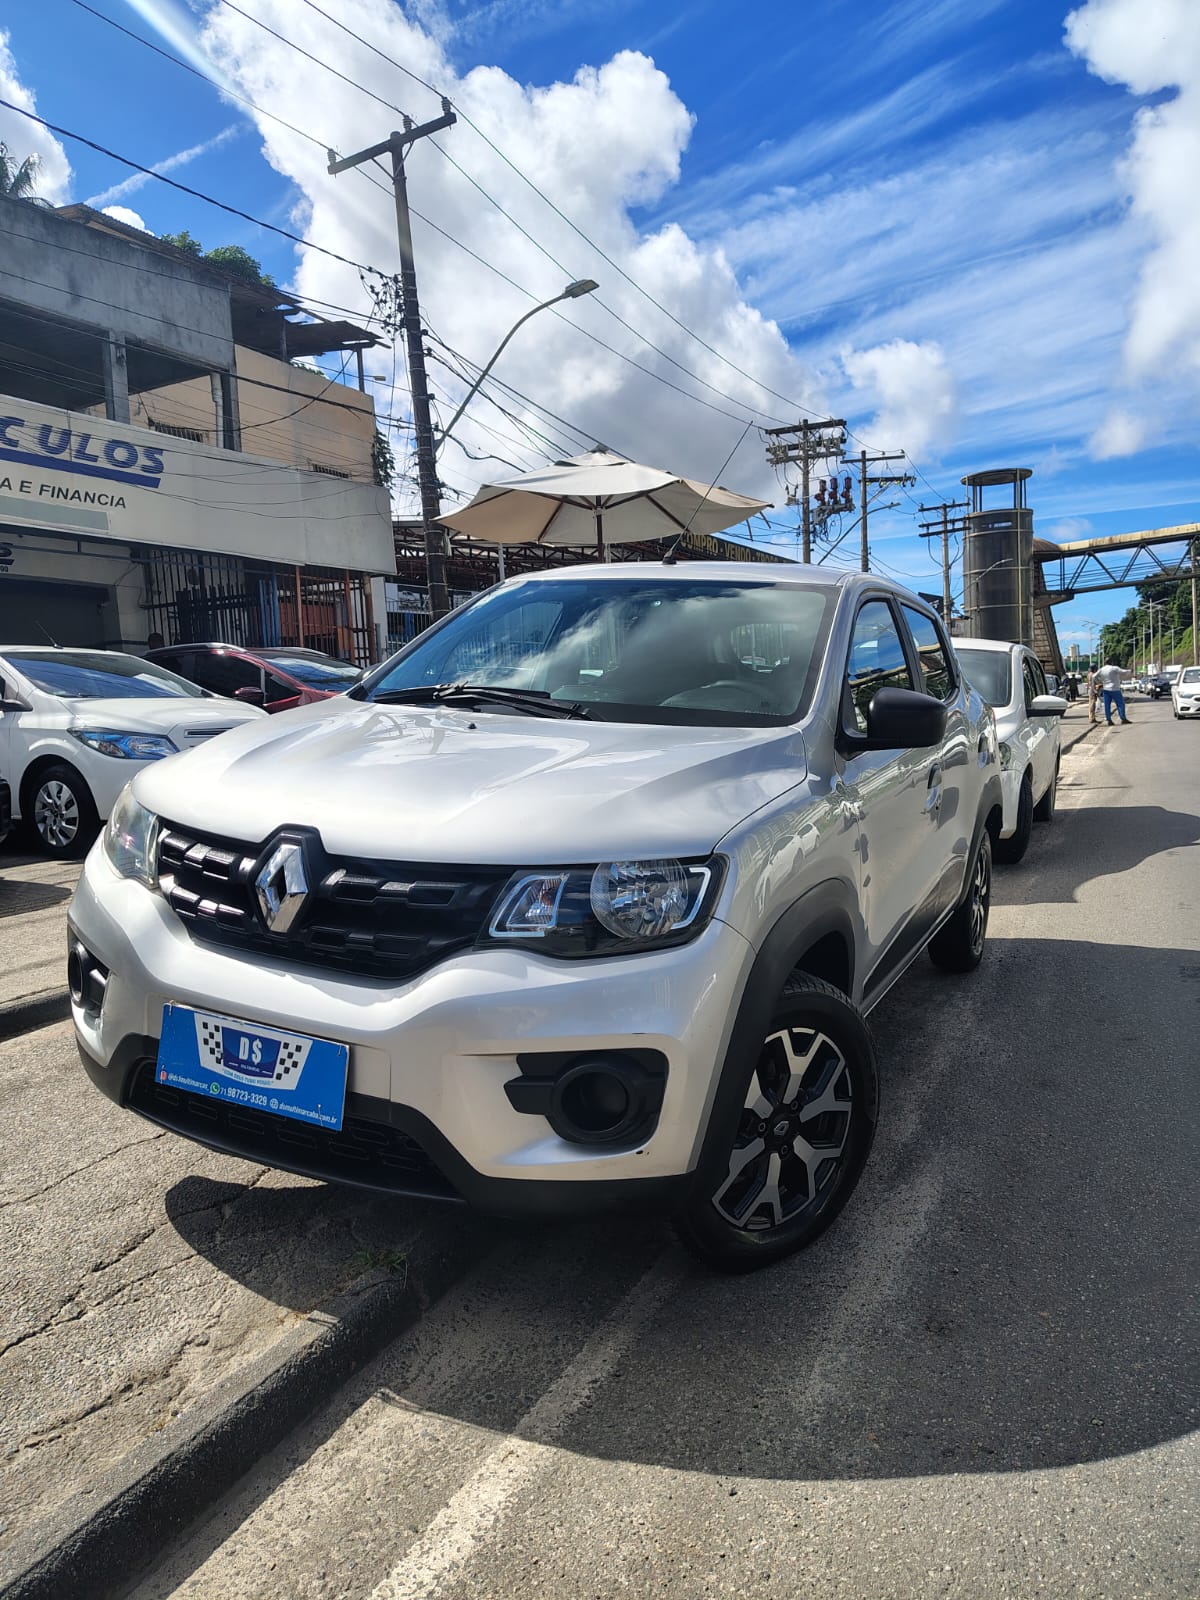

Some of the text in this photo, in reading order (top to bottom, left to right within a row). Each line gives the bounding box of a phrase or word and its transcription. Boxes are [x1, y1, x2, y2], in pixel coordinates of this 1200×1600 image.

[19, 480, 33, 494] E
[38, 483, 127, 509] FINANCIA
[680, 530, 719, 556] COMPRO
[724, 541, 752, 561] VENDO
